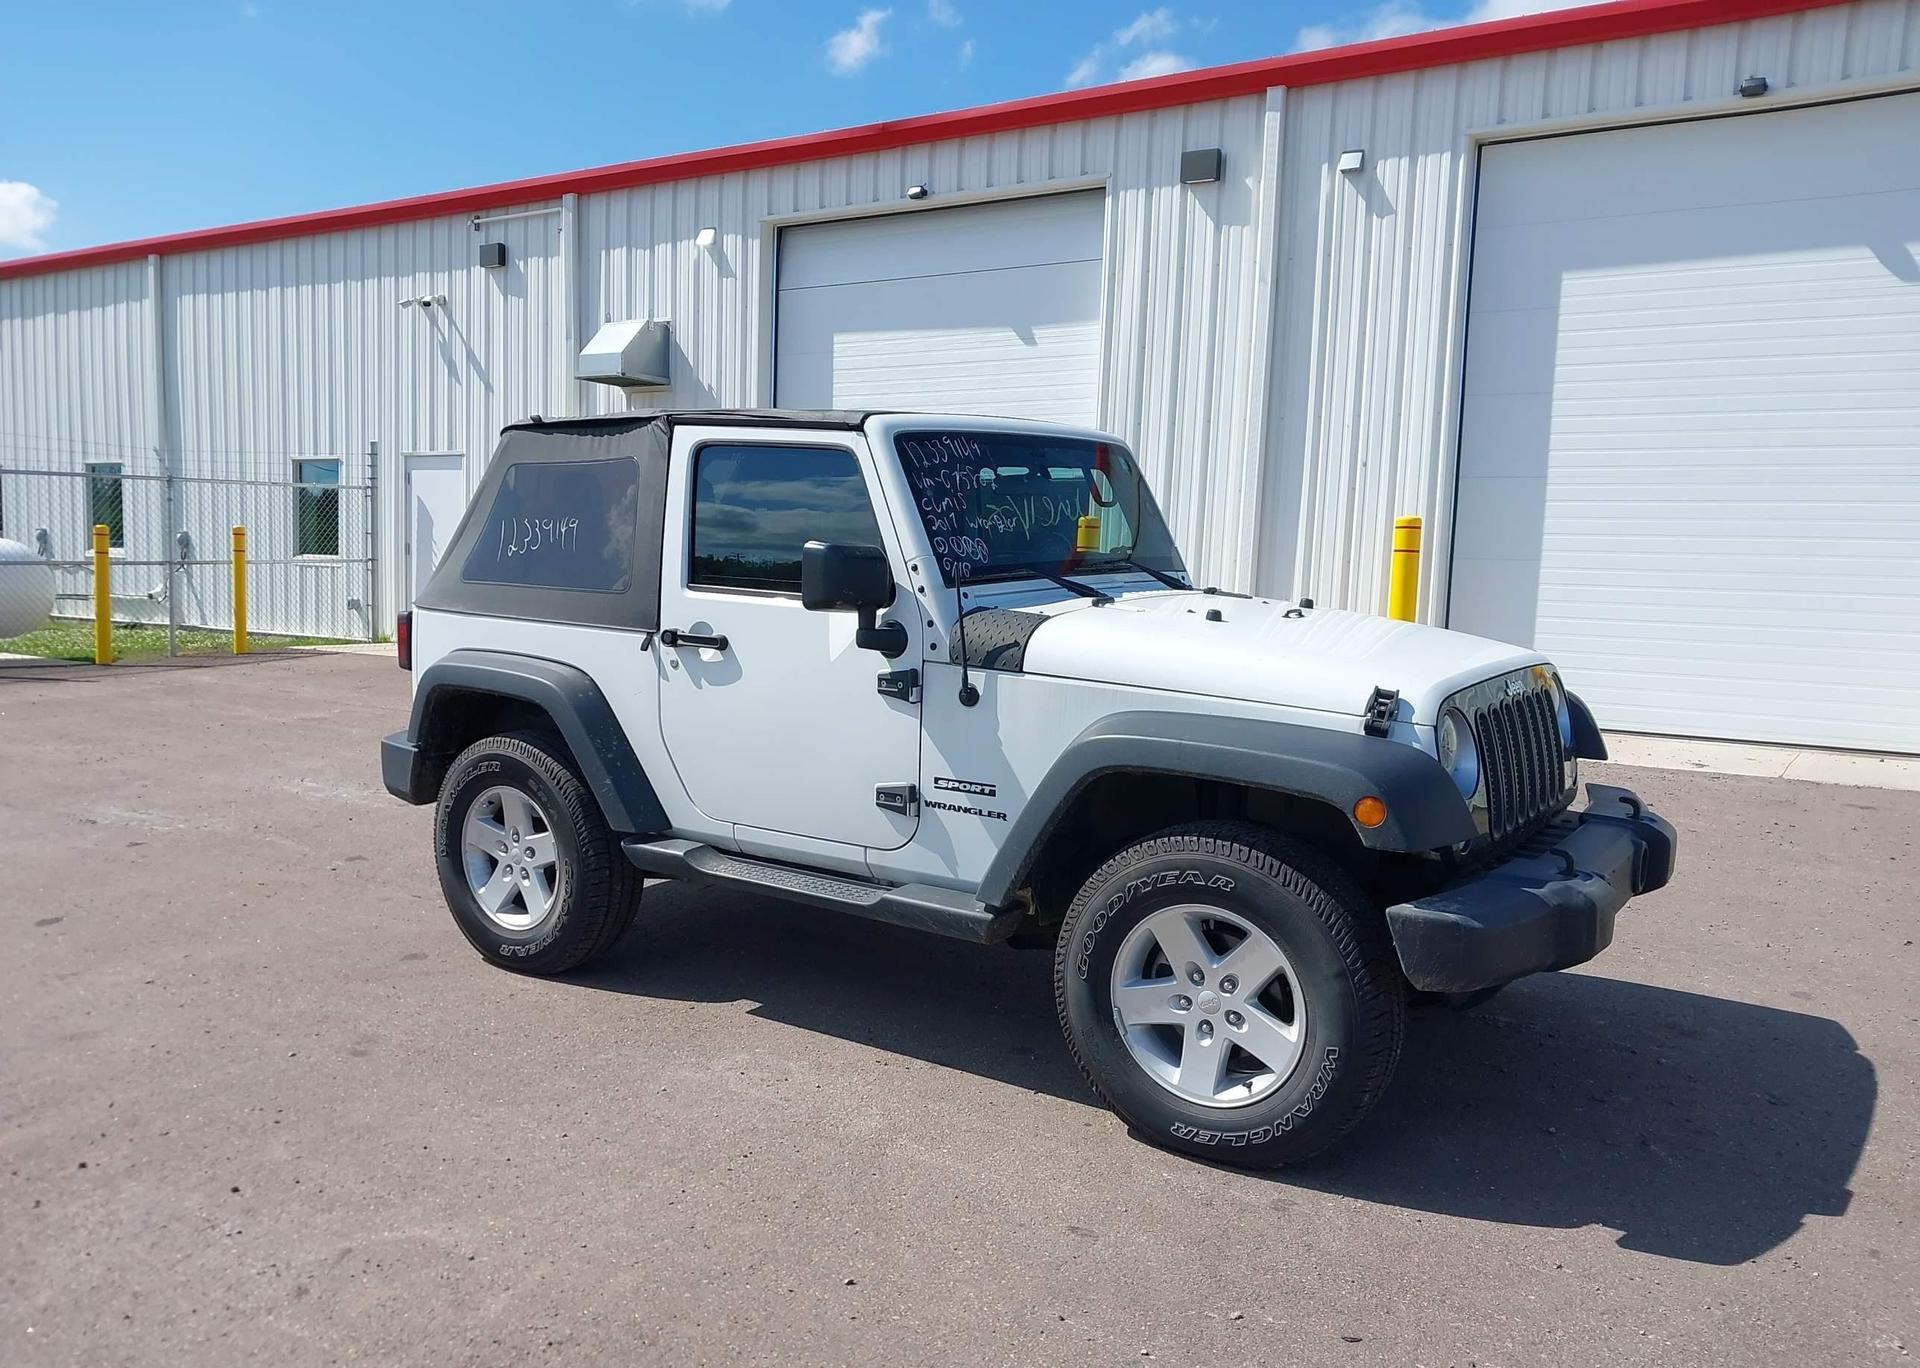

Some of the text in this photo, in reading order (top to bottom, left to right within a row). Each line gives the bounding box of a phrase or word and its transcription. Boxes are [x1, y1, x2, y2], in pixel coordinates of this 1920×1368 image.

[903, 436, 981, 468] 12339149
[927, 512, 958, 531] 2017
[497, 516, 579, 562] 12339149
[936, 777, 994, 796] SPORT
[924, 799, 1009, 822] WRANGLER
[1075, 870, 1237, 980] GOODYEAR
[1170, 1047, 1340, 1147] WRANGLER
